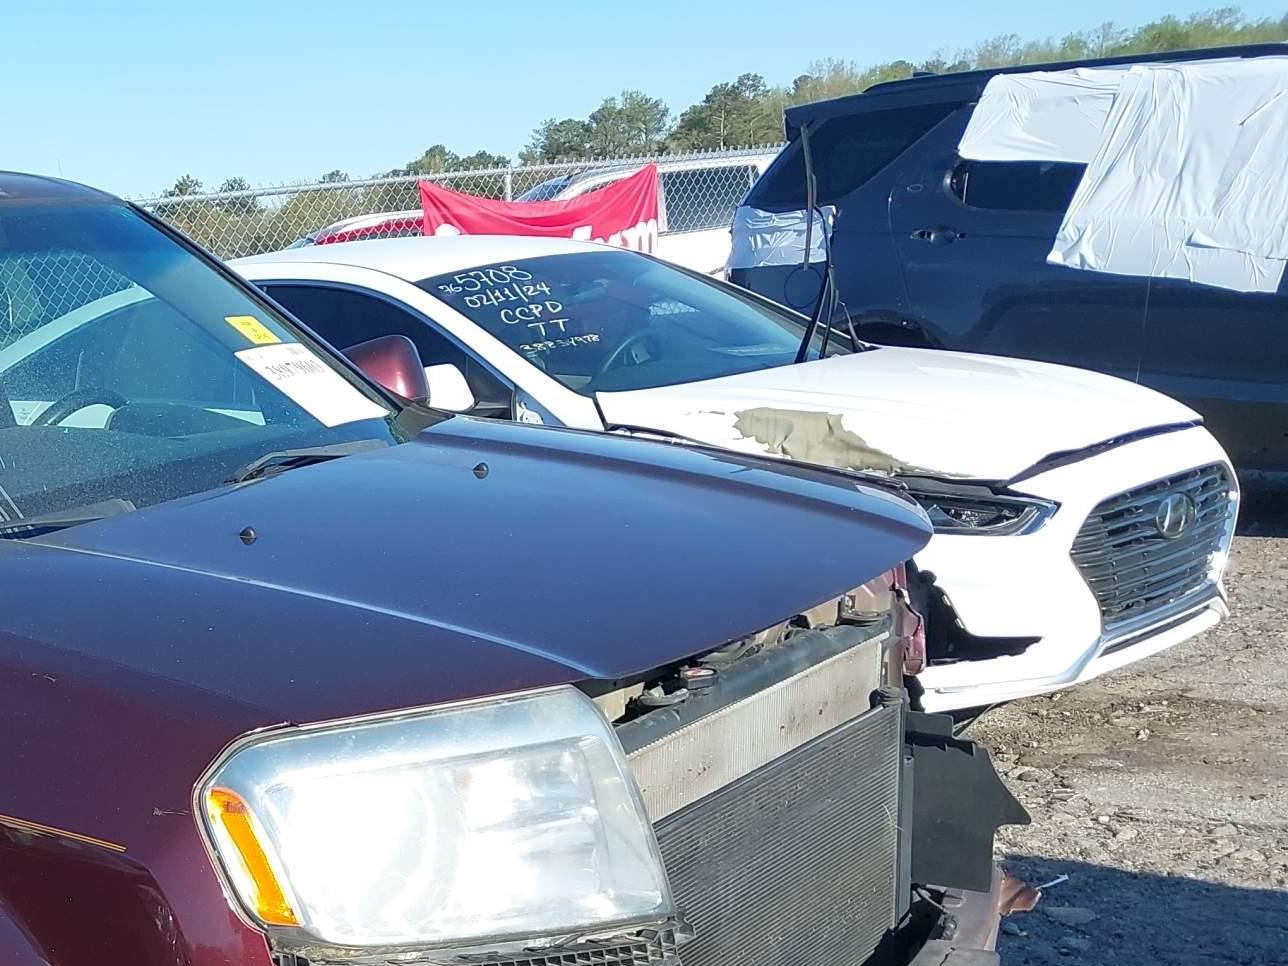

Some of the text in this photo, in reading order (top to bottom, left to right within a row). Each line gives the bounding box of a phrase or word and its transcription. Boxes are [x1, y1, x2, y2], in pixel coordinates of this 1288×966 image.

[454, 266, 532, 291] 5708
[464, 281, 551, 308] 02/11/24
[500, 301, 563, 324] CCPD
